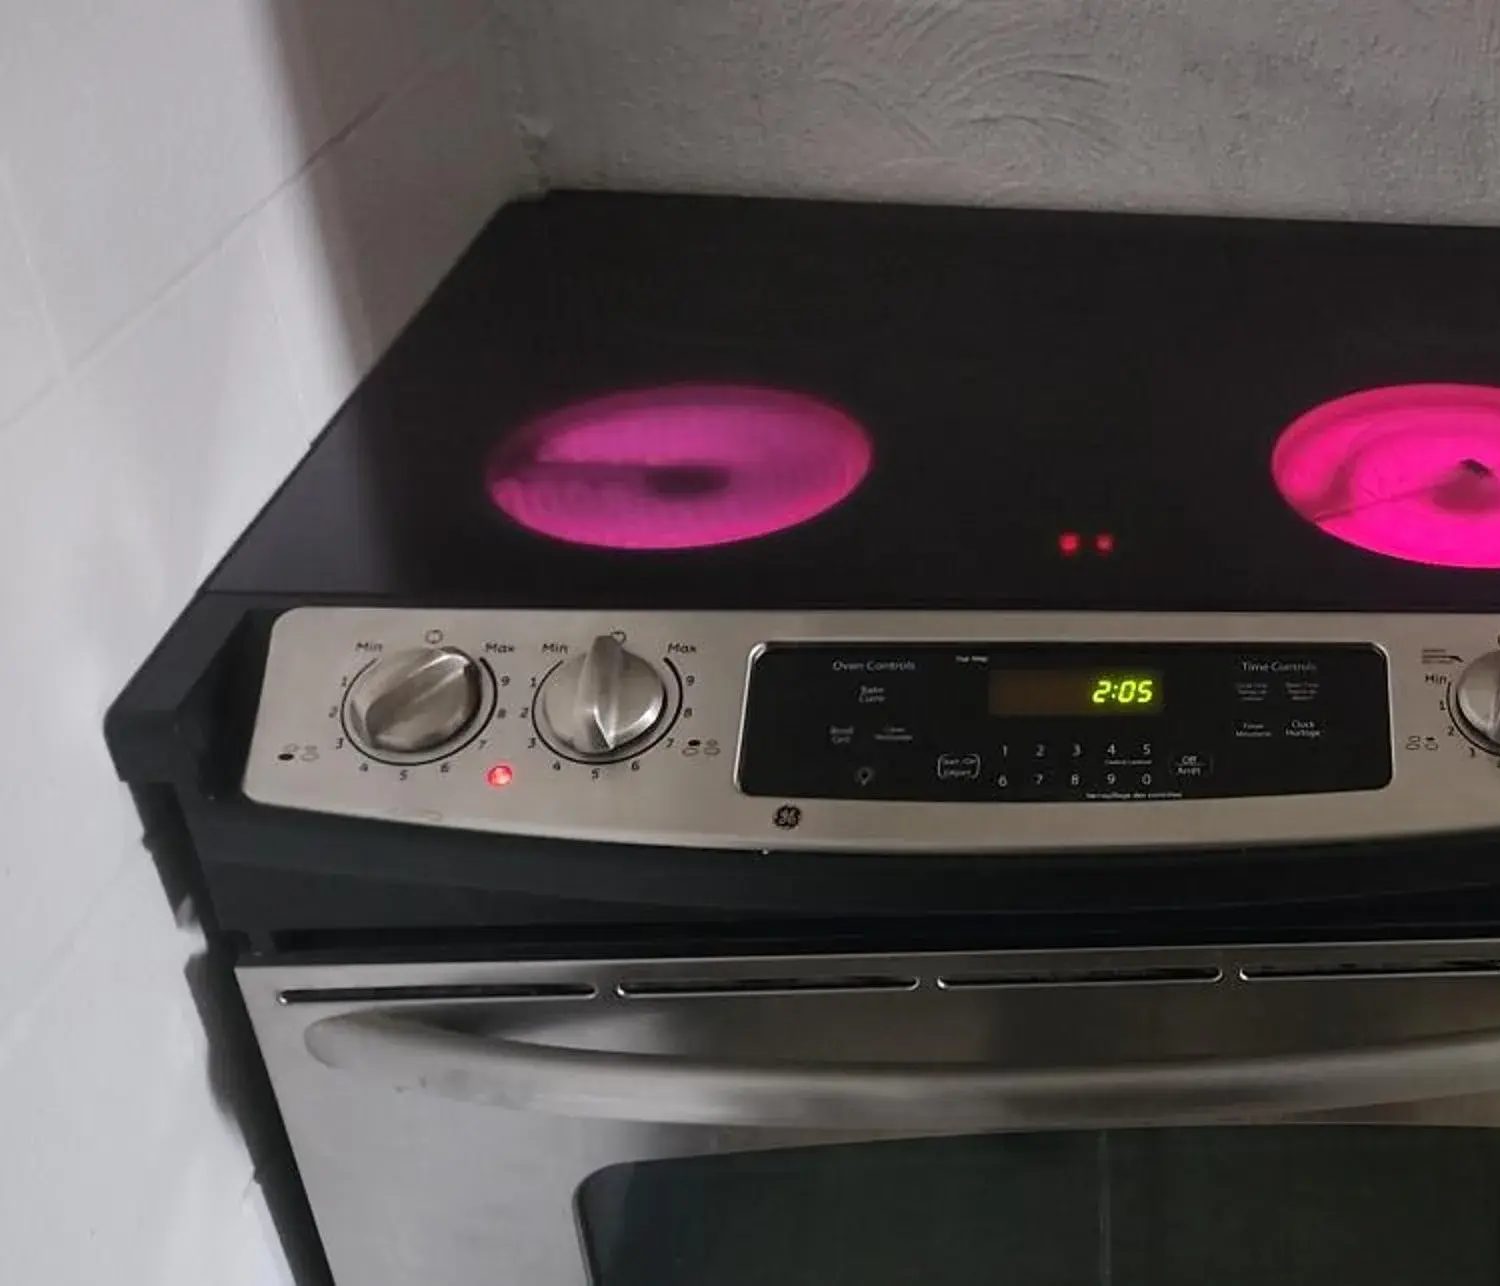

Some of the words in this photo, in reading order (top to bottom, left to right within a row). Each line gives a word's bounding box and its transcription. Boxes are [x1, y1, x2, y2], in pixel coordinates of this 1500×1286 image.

[357, 642, 383, 653] Min
[485, 642, 516, 654] Max
[542, 642, 568, 654] Min
[667, 642, 697, 654] Max
[866, 660, 916, 671] Controls
[1242, 661, 1269, 671] Time
[1425, 674, 1447, 684] Min
[1092, 681, 1153, 703] 2:05
